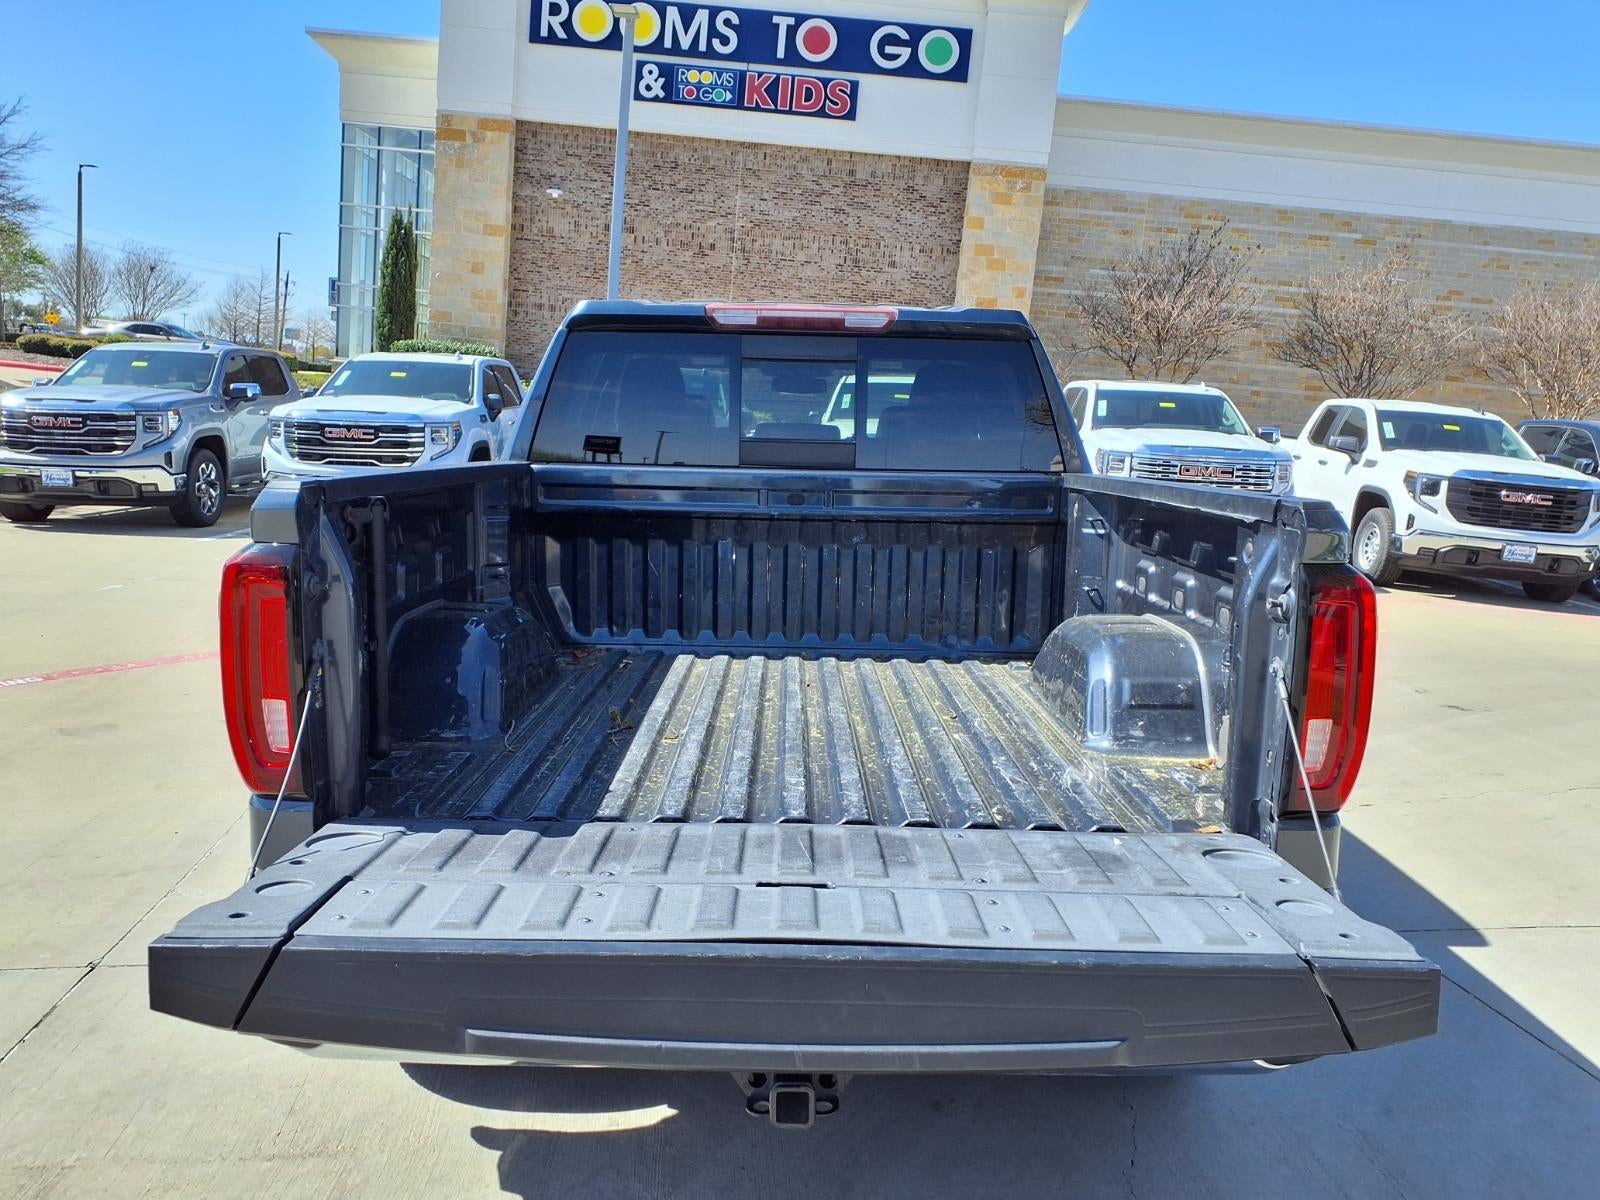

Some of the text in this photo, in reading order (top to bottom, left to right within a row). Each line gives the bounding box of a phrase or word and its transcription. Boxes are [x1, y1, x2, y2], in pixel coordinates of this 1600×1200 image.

[540, 0, 960, 73] ROOMS TO GO
[638, 63, 666, 98] &
[678, 69, 734, 86] ROOMS
[678, 85, 726, 102] TO GO
[744, 71, 851, 117] KIDS
[31, 415, 83, 427] GMC
[324, 427, 375, 439] GMC
[1181, 465, 1233, 478] GMC
[1500, 489, 1553, 506] GMC
